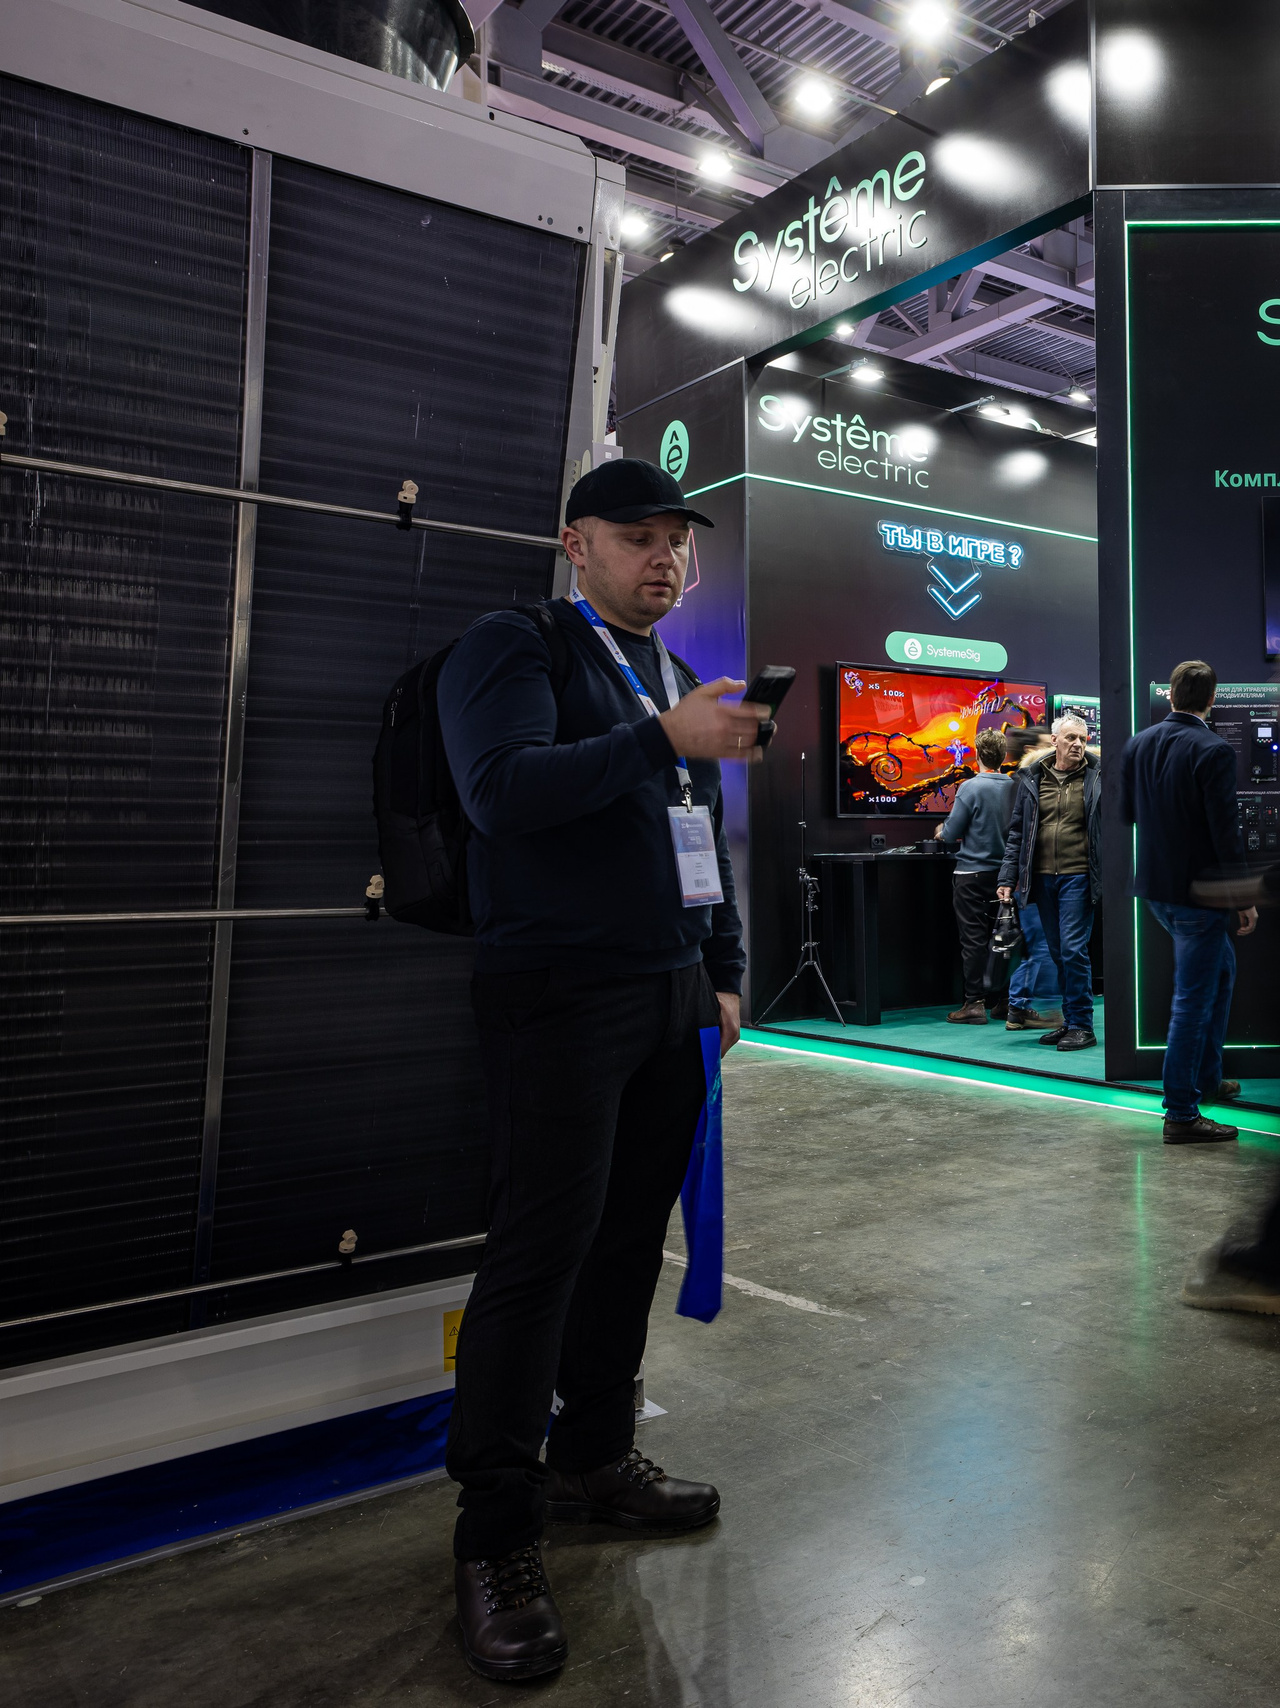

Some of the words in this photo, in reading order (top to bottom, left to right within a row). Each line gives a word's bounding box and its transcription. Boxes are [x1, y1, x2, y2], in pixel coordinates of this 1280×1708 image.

[732, 149, 927, 293] Systême
[789, 209, 928, 310] electric
[757, 394, 930, 463] Systême
[817, 446, 930, 489] electric
[881, 523, 922, 549] ТЫ
[926, 531, 944, 553] В
[949, 534, 1006, 564] ИГРЕ
[926, 644, 981, 662] SystemeSig
[883, 689, 905, 698] 100%
